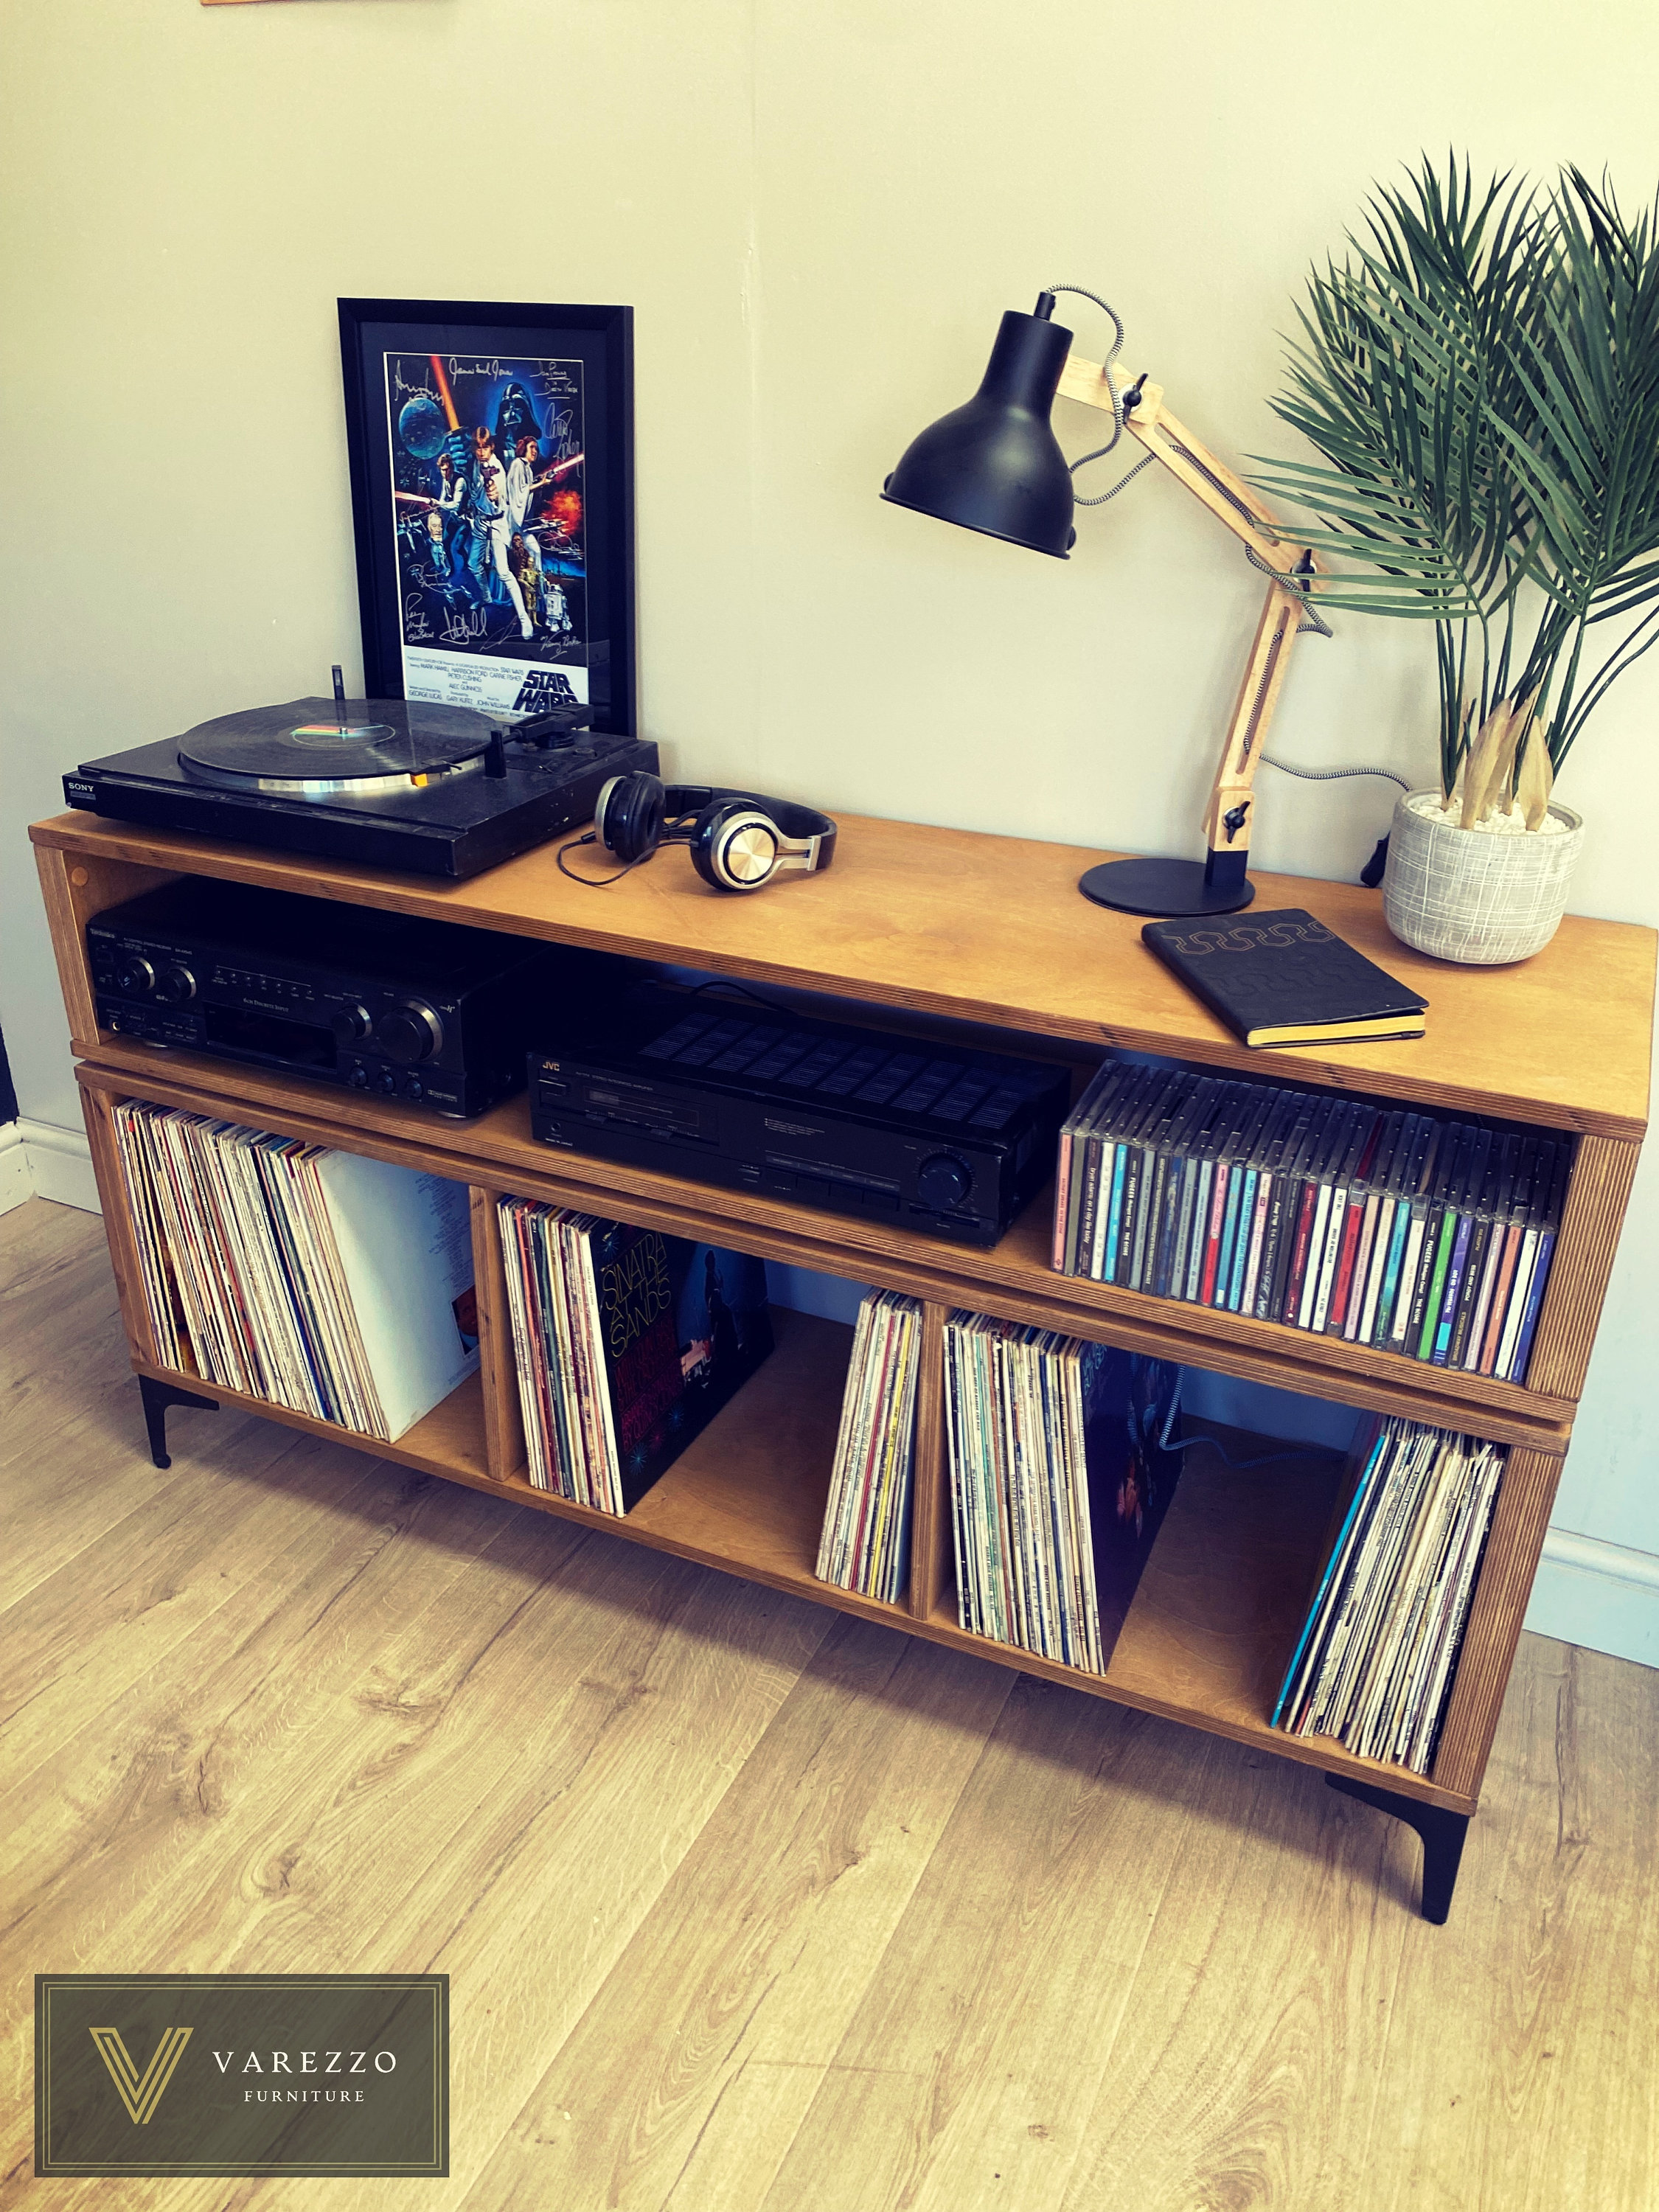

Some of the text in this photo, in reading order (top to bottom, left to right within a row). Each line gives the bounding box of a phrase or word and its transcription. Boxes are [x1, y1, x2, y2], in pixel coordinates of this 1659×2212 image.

[523, 669, 576, 695] STAR
[68, 782, 94, 792] SONY
[542, 1061, 560, 1071] JVC
[1088, 1166, 1096, 1182] bryan
[1085, 1199, 1093, 1207] on
[1084, 1211, 1093, 1221] day
[1084, 1220, 1092, 1230] like
[1082, 1229, 1091, 1244] today
[1422, 1239, 1434, 1263] FUGEES
[602, 1231, 667, 1310] SINATRA
[1467, 1276, 1475, 1285] AND
[611, 1264, 669, 1332] AT THE
[1414, 1298, 1423, 1308] THE
[611, 1277, 671, 1357] SANDS
[1411, 1307, 1422, 1325] SCORE
